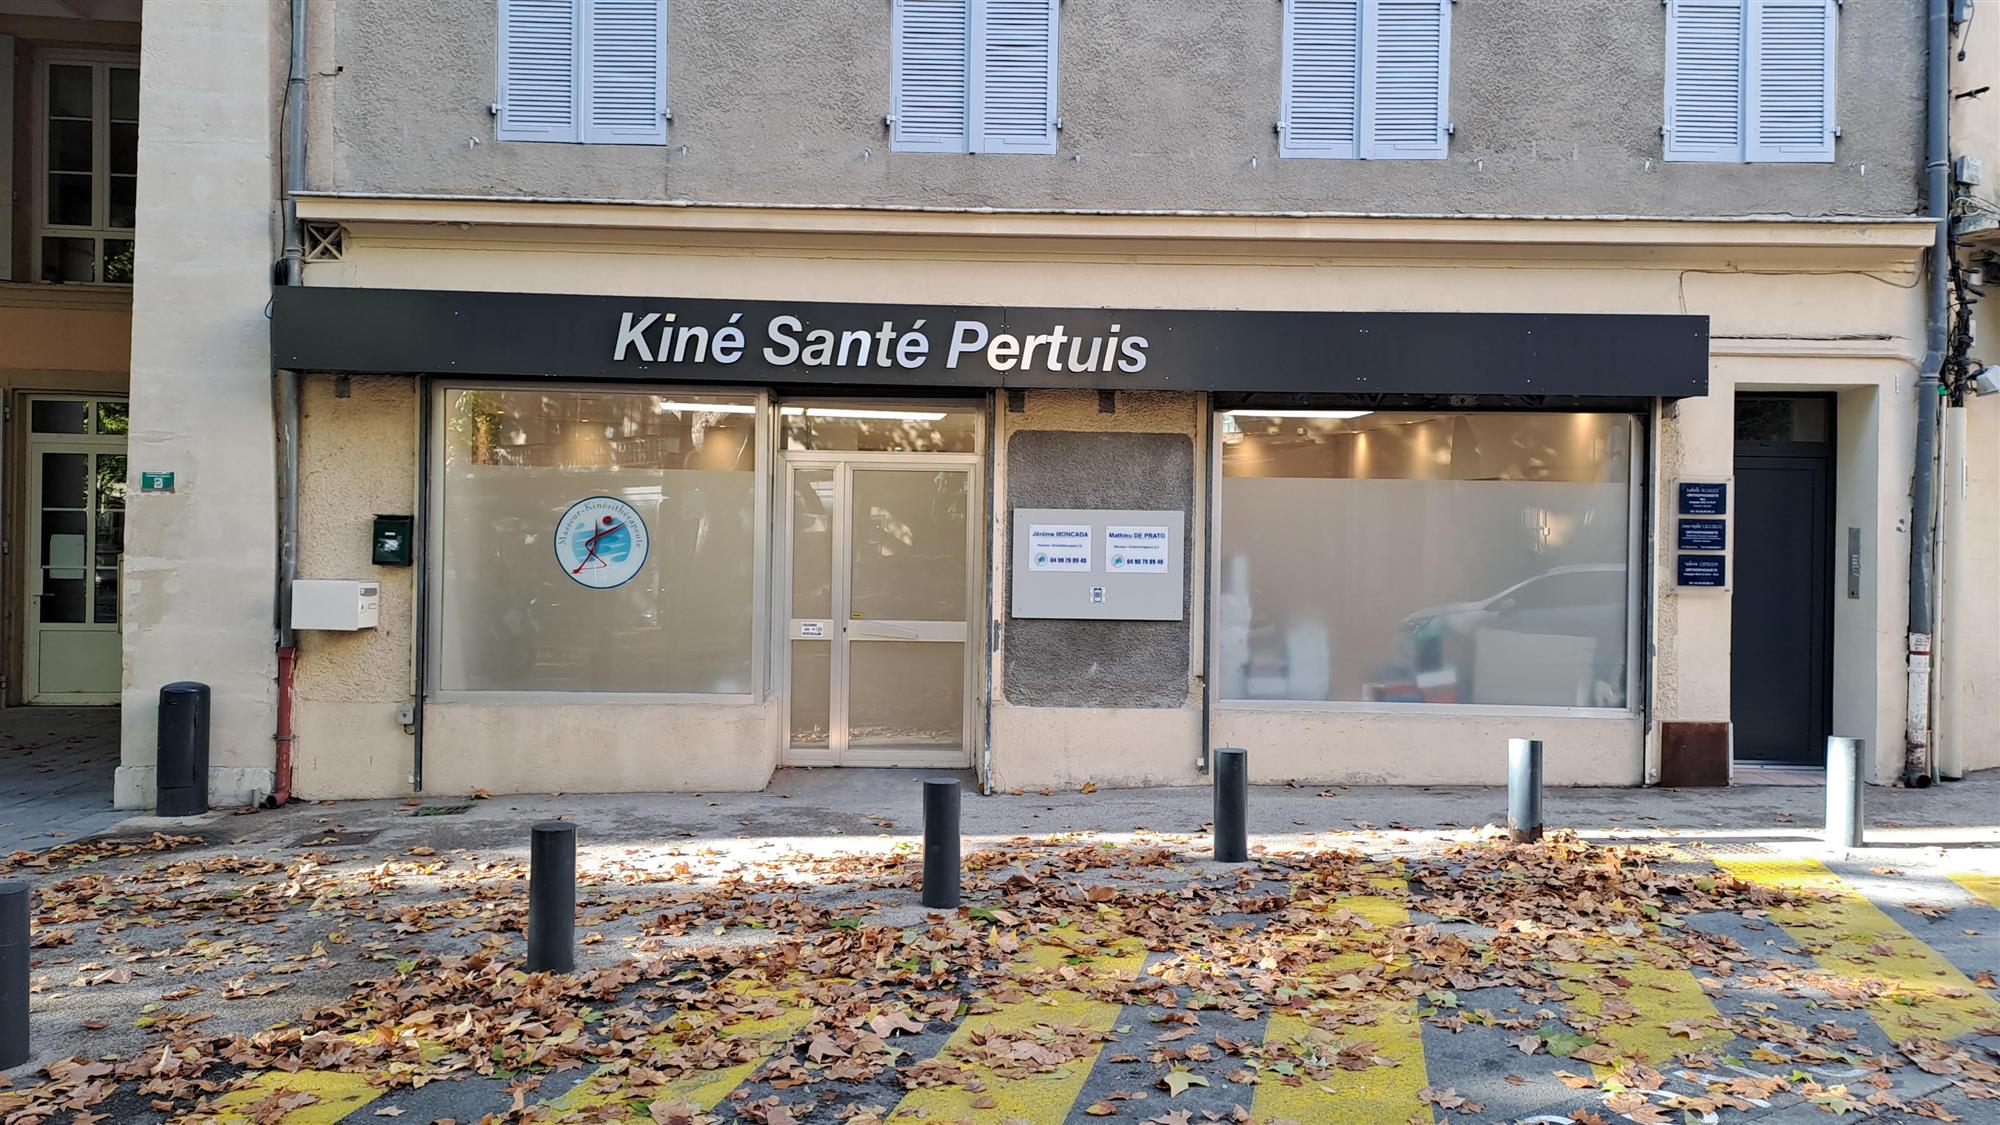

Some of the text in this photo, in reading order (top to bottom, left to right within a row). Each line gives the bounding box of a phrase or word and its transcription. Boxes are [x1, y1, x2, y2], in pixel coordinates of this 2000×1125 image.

[612, 312, 1150, 373] Kiné Santé Pertuis
[558, 501, 644, 549] Masseur-Kinésithérapeute
